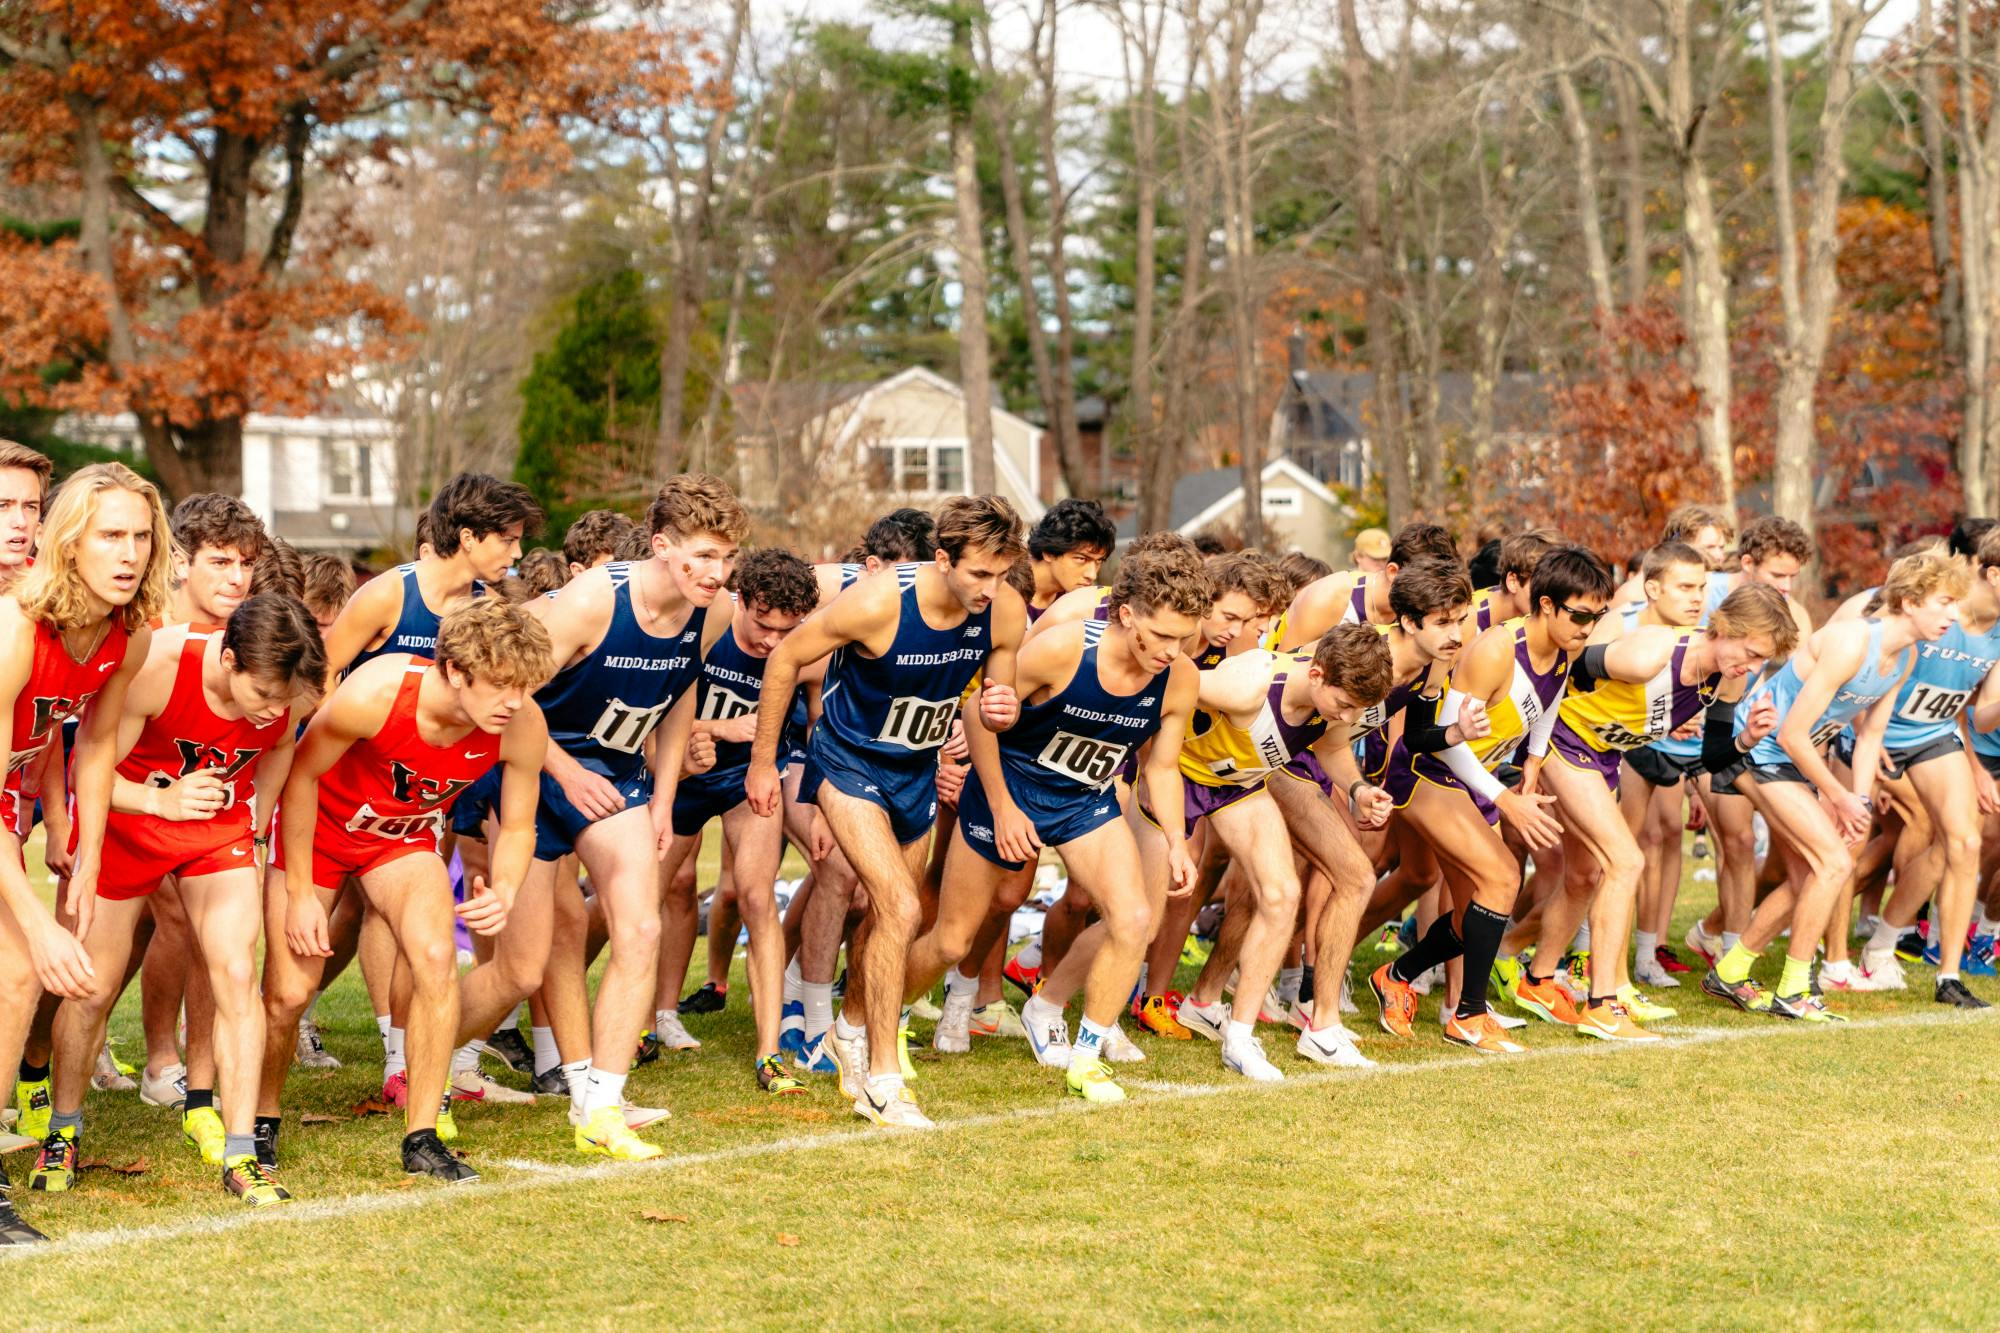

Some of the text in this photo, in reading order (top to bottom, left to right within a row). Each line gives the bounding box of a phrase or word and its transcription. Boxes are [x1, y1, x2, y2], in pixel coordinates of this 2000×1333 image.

[603, 655, 691, 671] MIDDLEBURY
[896, 648, 984, 666] MIDDLEBURY
[1062, 704, 1149, 729] MIDDLEBURY
[1908, 688, 1965, 719] 146
[889, 701, 954, 745] 103
[1049, 736, 1122, 781] 105
